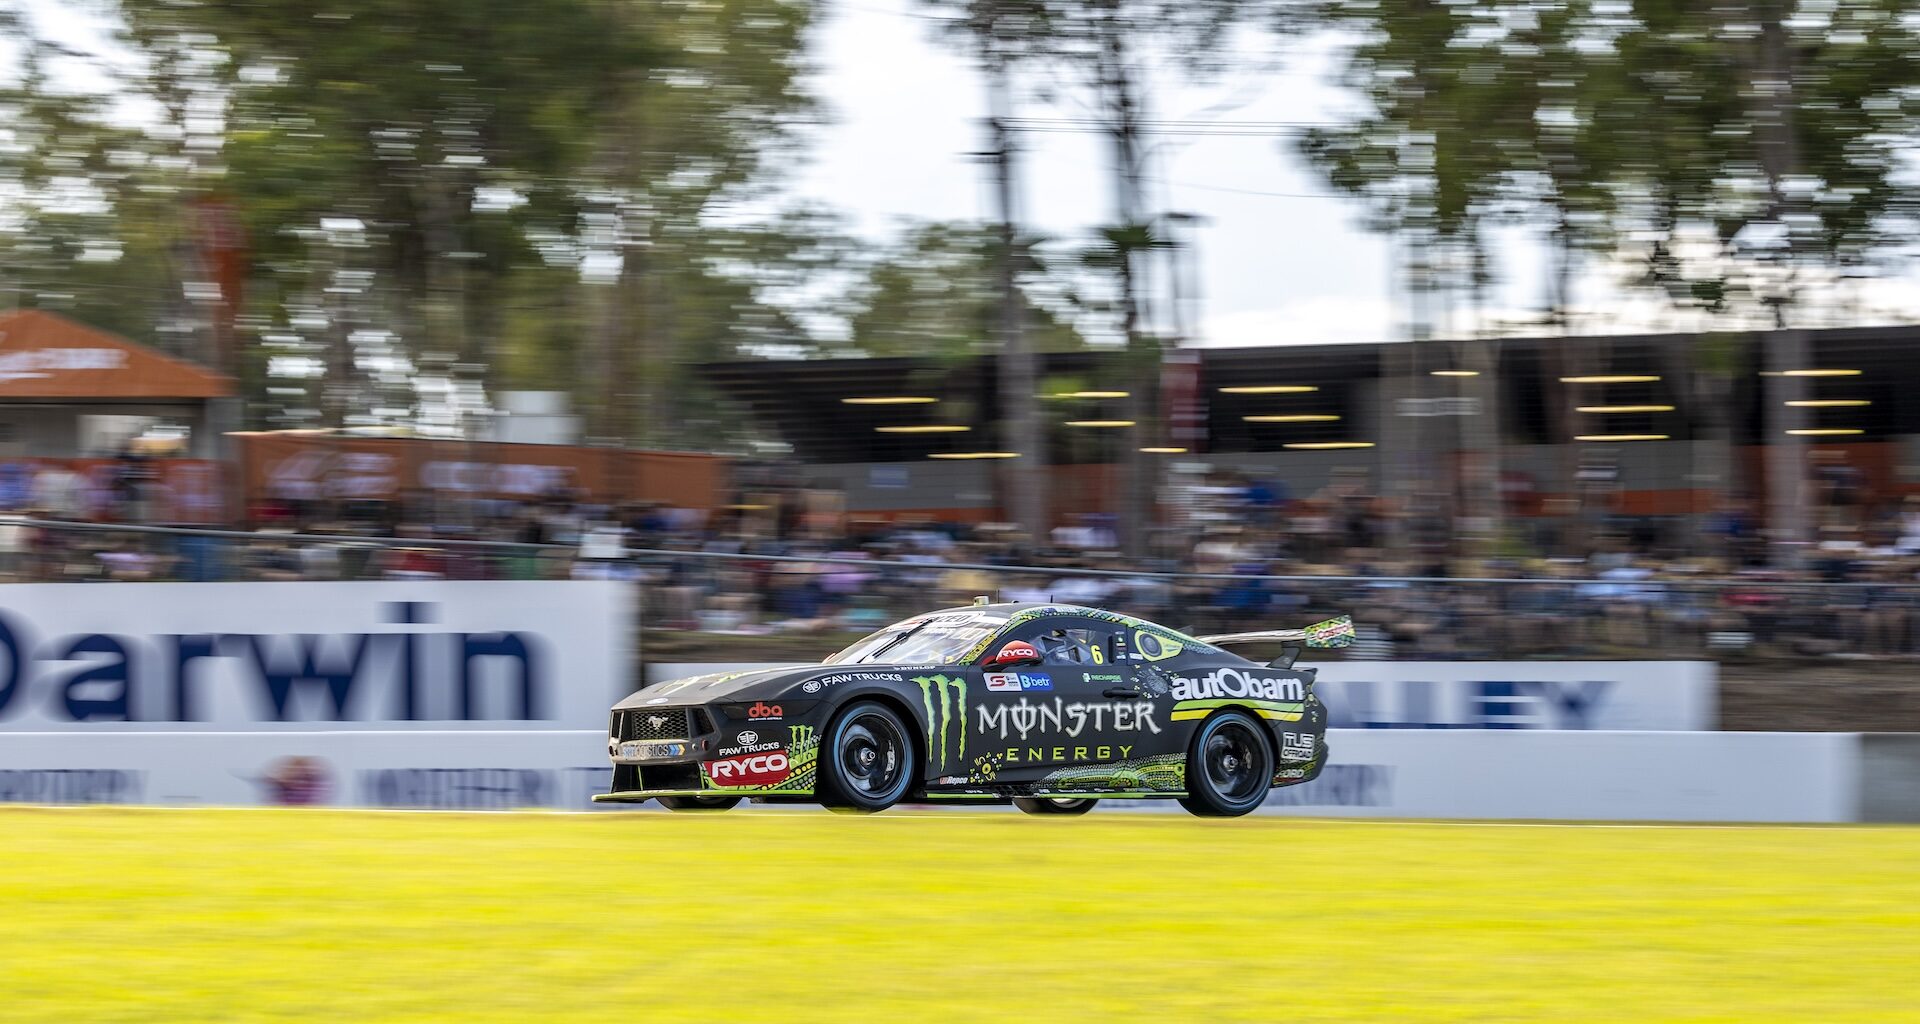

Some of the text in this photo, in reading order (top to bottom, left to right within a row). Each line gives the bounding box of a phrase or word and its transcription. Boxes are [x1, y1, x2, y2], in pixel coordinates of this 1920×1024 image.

[999, 648, 1033, 657] RYCO
[1090, 645, 1104, 664] 6
[821, 673, 903, 686] FAW TRUCKS
[1031, 676, 1050, 687] betr
[748, 702, 783, 718] dba
[975, 696, 1162, 741] MONSTER
[719, 742, 780, 756] FAW TRUCKS
[1006, 745, 1134, 762] ENERGY
[711, 754, 788, 779] RYCO
